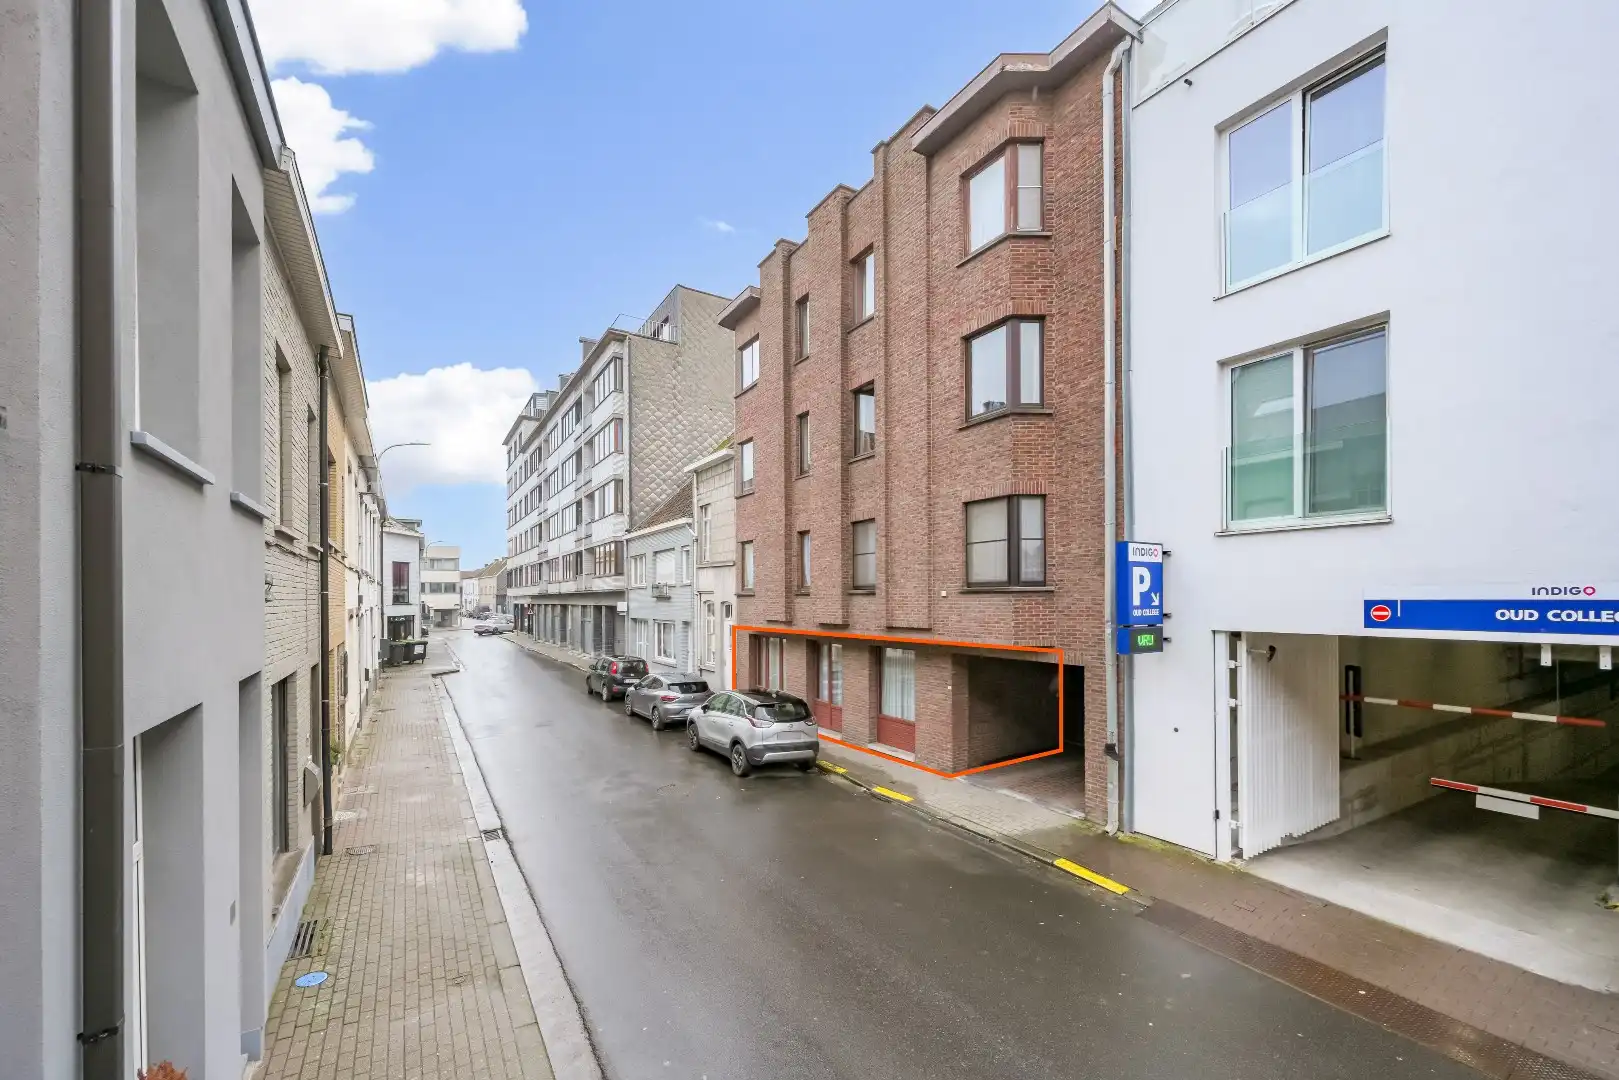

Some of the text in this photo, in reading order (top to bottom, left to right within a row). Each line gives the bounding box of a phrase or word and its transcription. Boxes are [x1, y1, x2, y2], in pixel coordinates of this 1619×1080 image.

[1133, 547, 1158, 557] INDIGO
[1133, 566, 1150, 606] P
[1531, 586, 1596, 596] INDIGO
[1495, 609, 1539, 621] OUD
